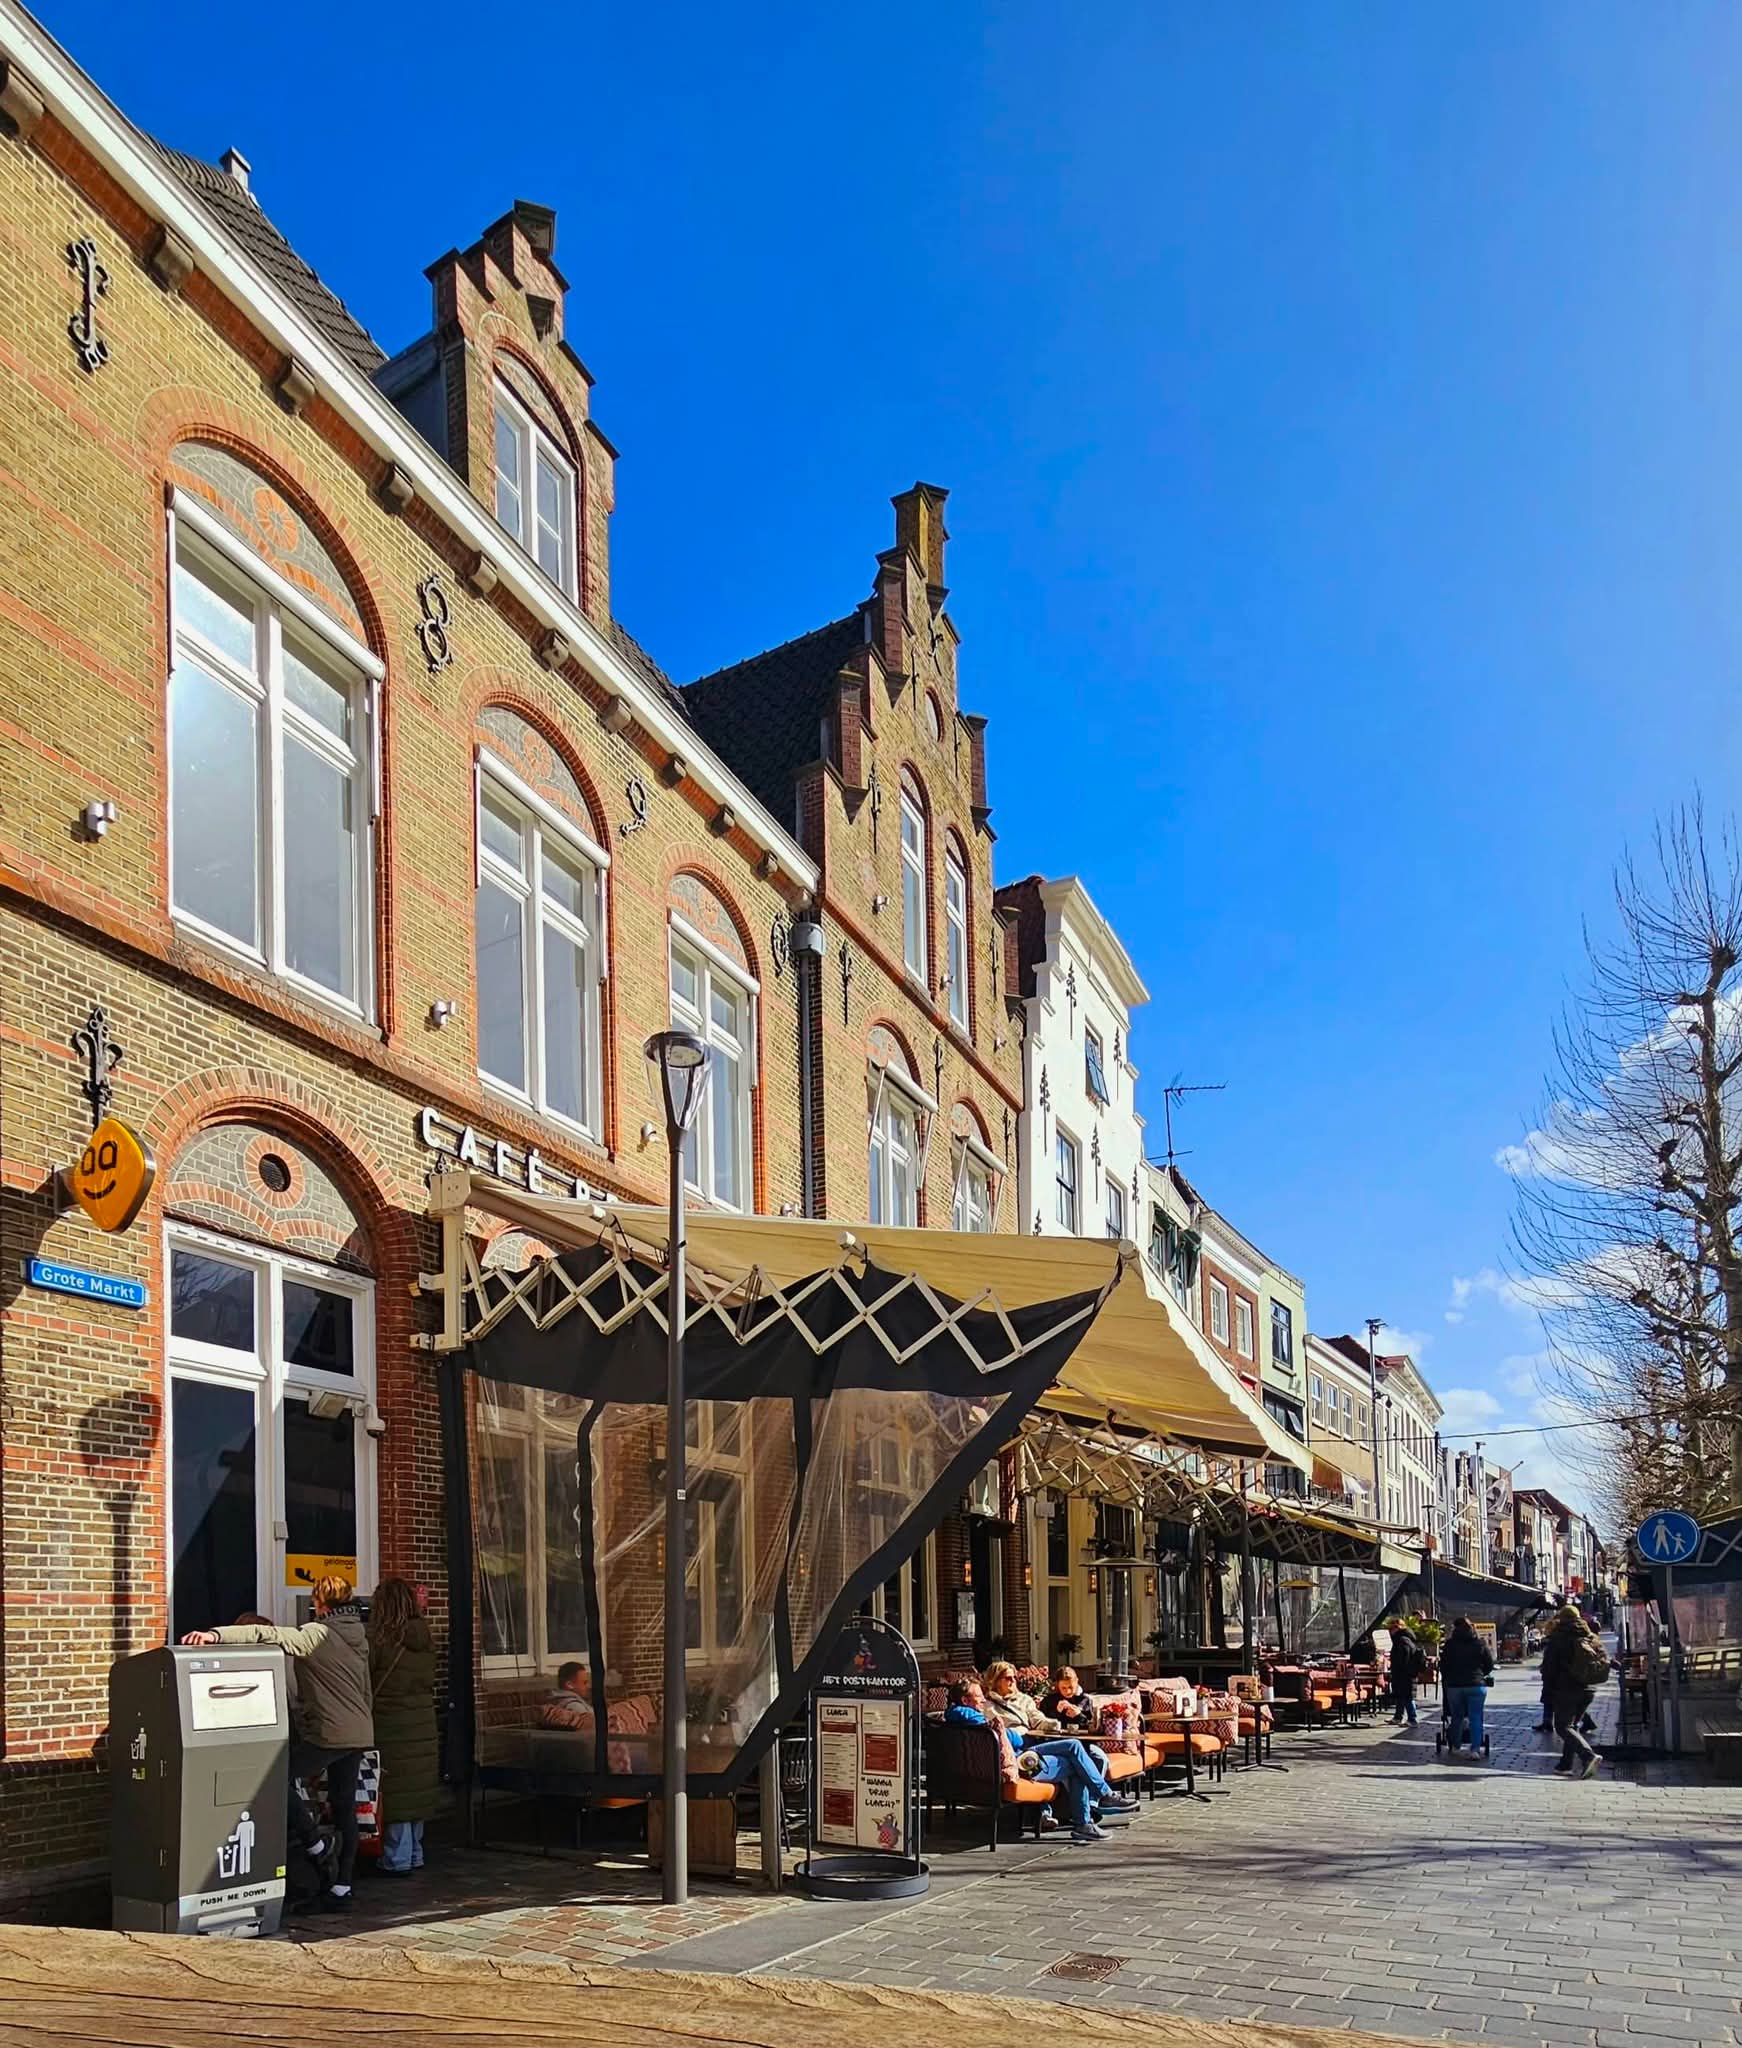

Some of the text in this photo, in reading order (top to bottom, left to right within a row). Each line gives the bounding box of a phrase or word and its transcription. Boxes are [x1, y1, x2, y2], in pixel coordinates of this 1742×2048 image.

[422, 1106, 545, 1195] CAFÉ
[41, 1267, 135, 1299] Grote Markt
[200, 1887, 267, 1906] PUSH ME DOWN
